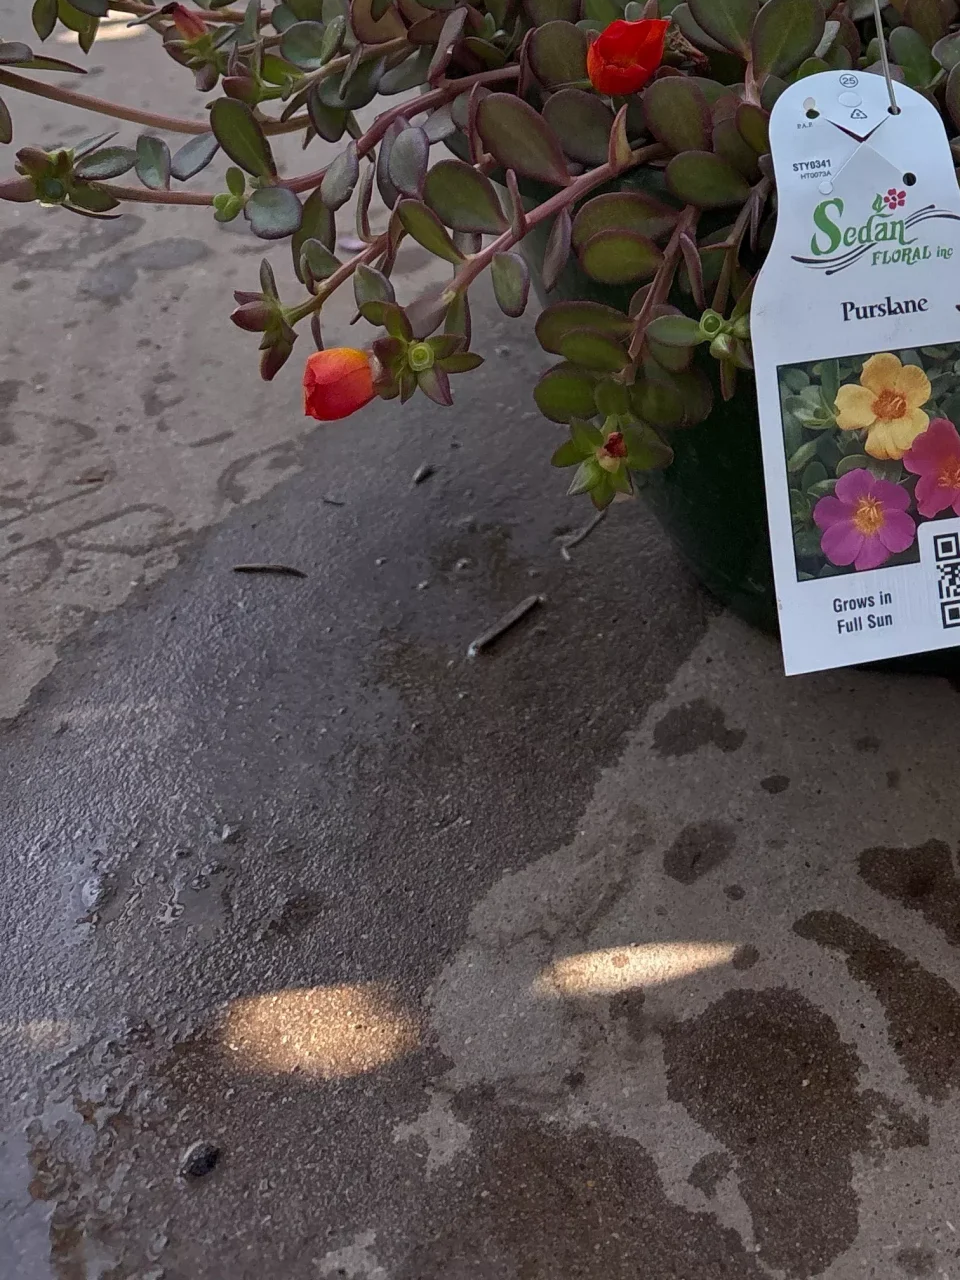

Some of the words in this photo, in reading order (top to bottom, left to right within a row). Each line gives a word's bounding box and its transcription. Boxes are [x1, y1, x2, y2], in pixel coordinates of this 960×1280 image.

[842, 77, 856, 85] 25
[792, 159, 832, 172] STY0341
[811, 197, 918, 256] Sedan
[871, 247, 931, 266] FLORAL
[936, 245, 953, 260] inc
[841, 296, 929, 322] Purslane
[833, 595, 875, 613] Grows
[879, 591, 893, 605] in
[837, 616, 863, 634] Full
[867, 613, 893, 629] Sun
